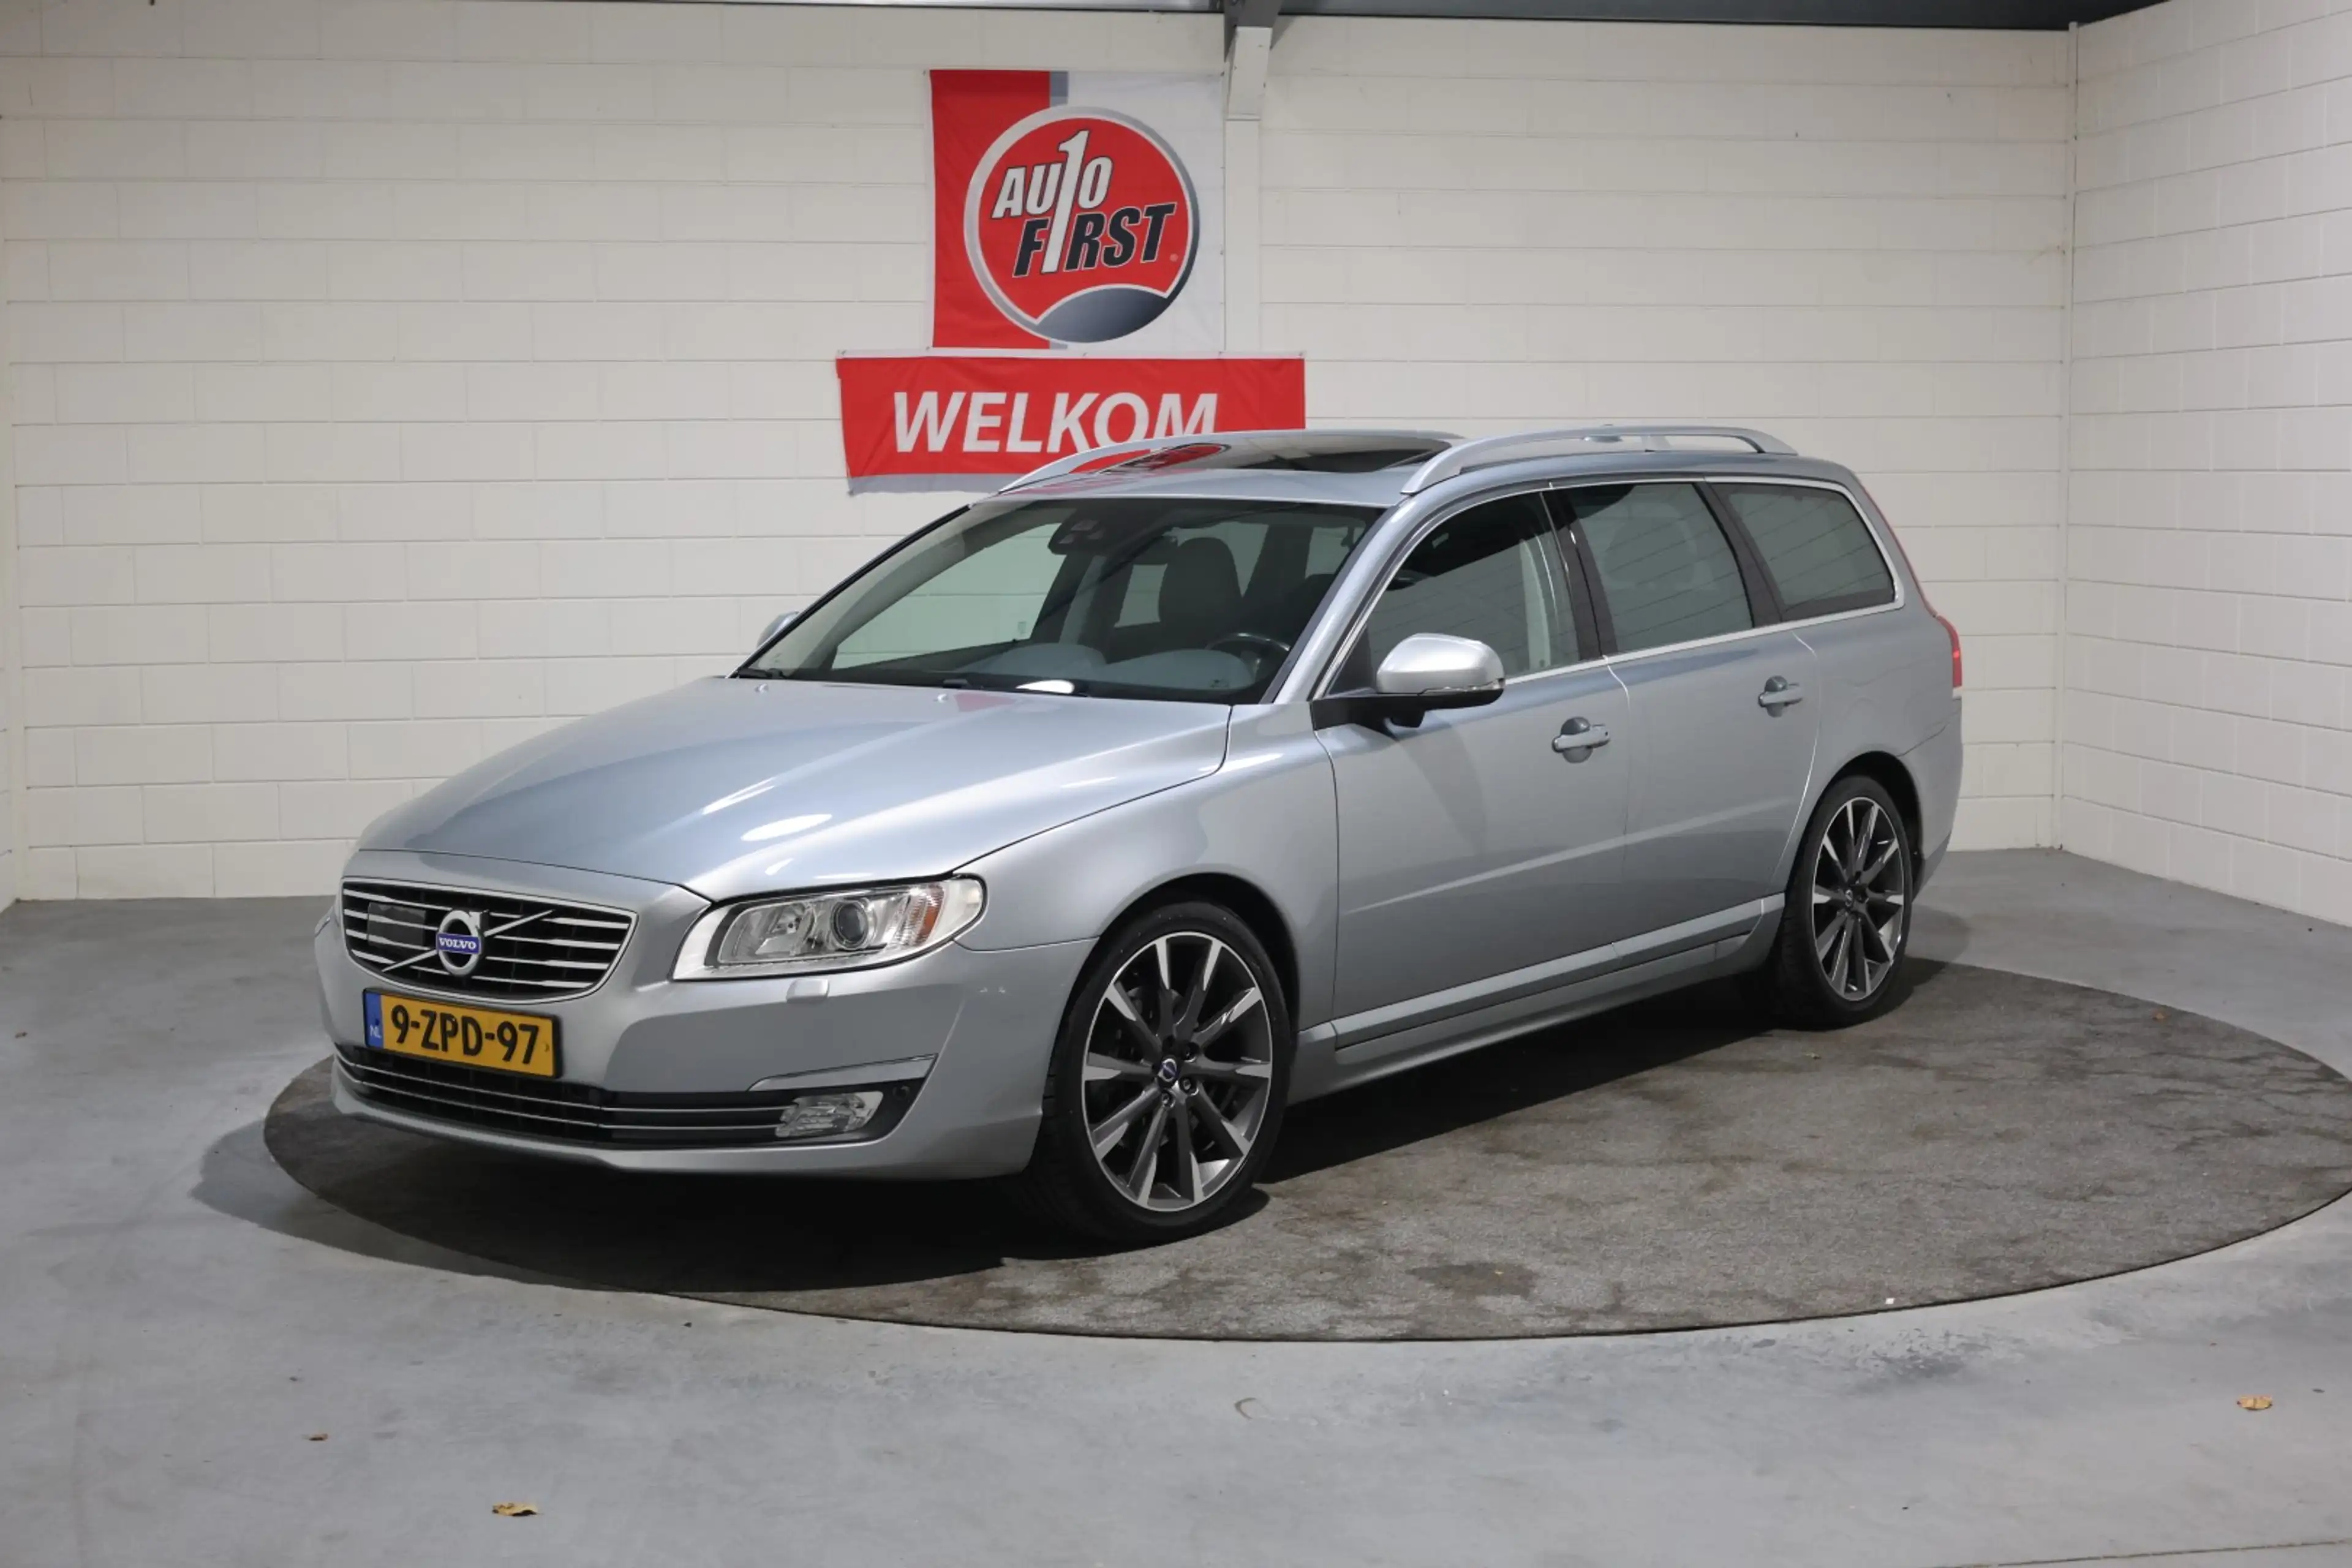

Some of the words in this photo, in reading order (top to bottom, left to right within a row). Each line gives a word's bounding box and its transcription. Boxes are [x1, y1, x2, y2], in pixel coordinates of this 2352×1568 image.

[894, 391, 1218, 453] WELKOM
[438, 937, 477, 950] VOLVO
[369, 1024, 382, 1039] NL
[391, 1005, 539, 1065] 9-ZPD-97
